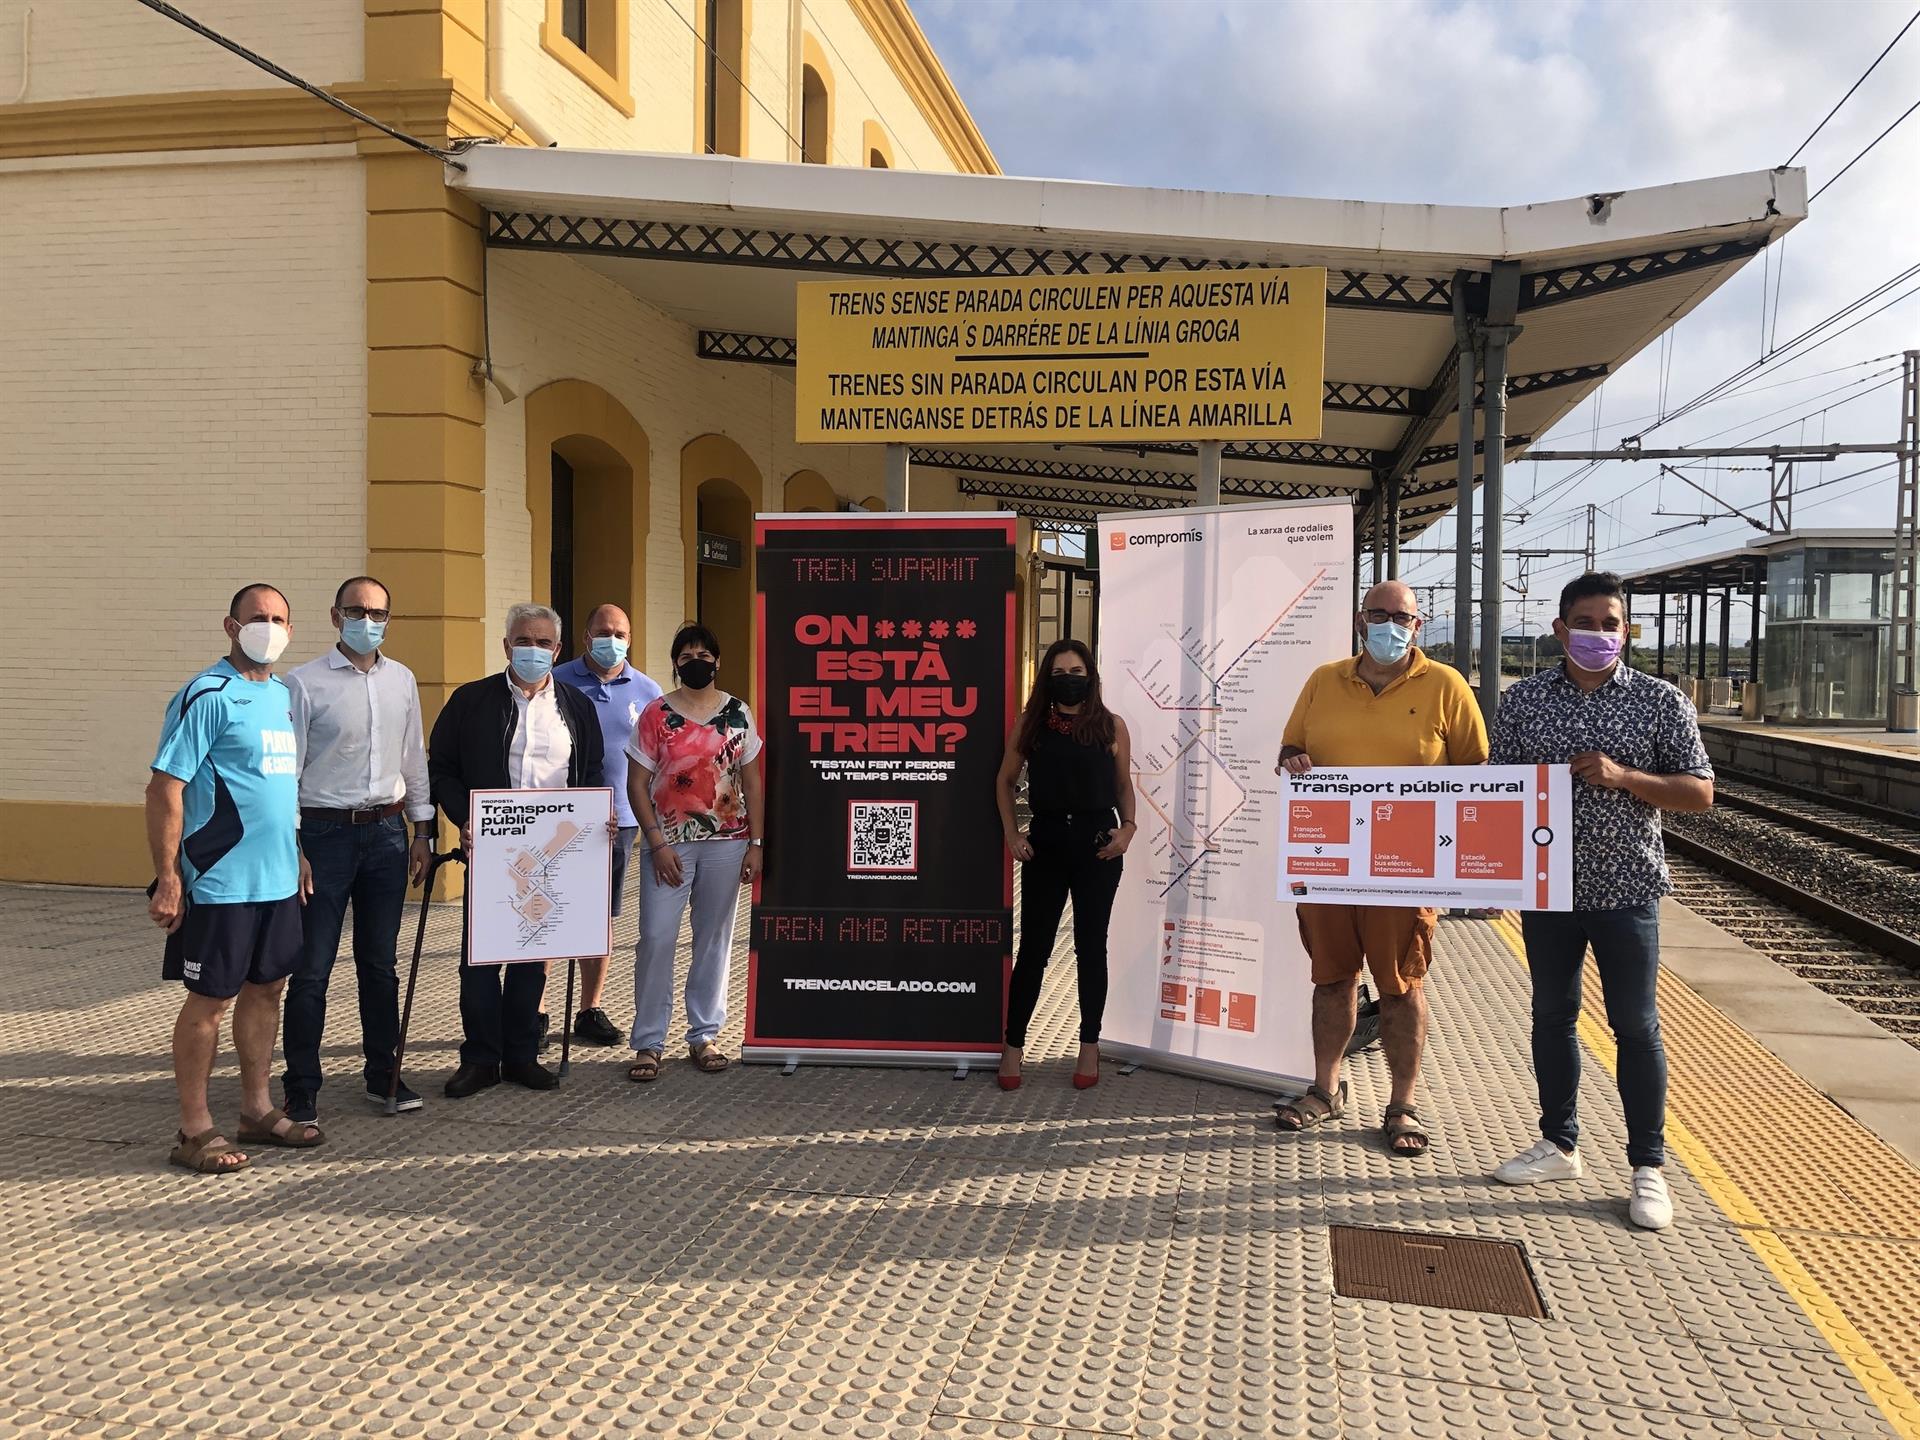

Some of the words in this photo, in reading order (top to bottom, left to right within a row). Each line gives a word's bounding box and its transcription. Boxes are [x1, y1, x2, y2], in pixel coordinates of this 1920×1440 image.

[829, 291, 885, 316] TRENS
[891, 289, 951, 314] SENSE
[955, 287, 1024, 313] PARADA
[1028, 284, 1121, 311] CIRCULEN
[1126, 284, 1163, 309] PER
[1168, 281, 1255, 308] AQUESTA
[1260, 275, 1291, 306] VÍA
[981, 316, 1061, 347] DARRÉRE
[1066, 322, 1091, 345] DE
[1096, 321, 1119, 345] LA
[1124, 313, 1170, 344] LÍNIA
[1175, 318, 1241, 343] GROGA
[828, 372, 905, 397] TRENES
[911, 371, 944, 396] SIN
[949, 369, 1027, 395] PARADA
[1032, 368, 1138, 394] CIRCULAN
[1144, 368, 1188, 393] POR
[1194, 367, 1247, 392] ESTA
[1252, 361, 1287, 391] VÍA
[819, 405, 966, 431] MANTENGANSE
[971, 399, 1049, 431] DETRÁS
[1054, 404, 1082, 429] DE
[1088, 404, 1113, 429] LA
[1119, 398, 1182, 428] LÍNEA
[1187, 402, 1293, 427] AMARILLA
[1129, 528, 1203, 547] compromís
[1248, 527, 1258, 536] La
[1259, 527, 1282, 535] xarxa
[1284, 526, 1295, 534] de
[1296, 523, 1334, 534] rodalies
[1287, 536, 1305, 545] que
[1306, 533, 1334, 543] volem
[792, 557, 857, 582] TREN
[871, 556, 980, 582] SUPRIMIT
[816, 640, 950, 681] ESTÀ
[789, 686, 850, 717] EL
[865, 686, 978, 717] MEU
[798, 722, 967, 753] TREN?
[810, 760, 865, 769] T'ESTAN
[868, 760, 901, 769] FENT
[905, 760, 956, 770] PERDRE
[821, 771, 840, 780] UN
[843, 771, 889, 780] TEMPS
[892, 769, 948, 781] PRECIÓS
[1290, 773, 1349, 781] PROPOSTA
[1290, 781, 1394, 796] Transport
[1400, 780, 1464, 796] públic
[1469, 780, 1524, 794] rural
[481, 803, 575, 816] Transport
[481, 814, 536, 827] públic
[481, 825, 526, 836] rural
[1293, 826, 1323, 834] Transport
[760, 916, 824, 942] TREN
[839, 917, 888, 943] AMB
[903, 918, 1003, 945] RETARD
[783, 978, 976, 994] TRENCANCELADO.COM
